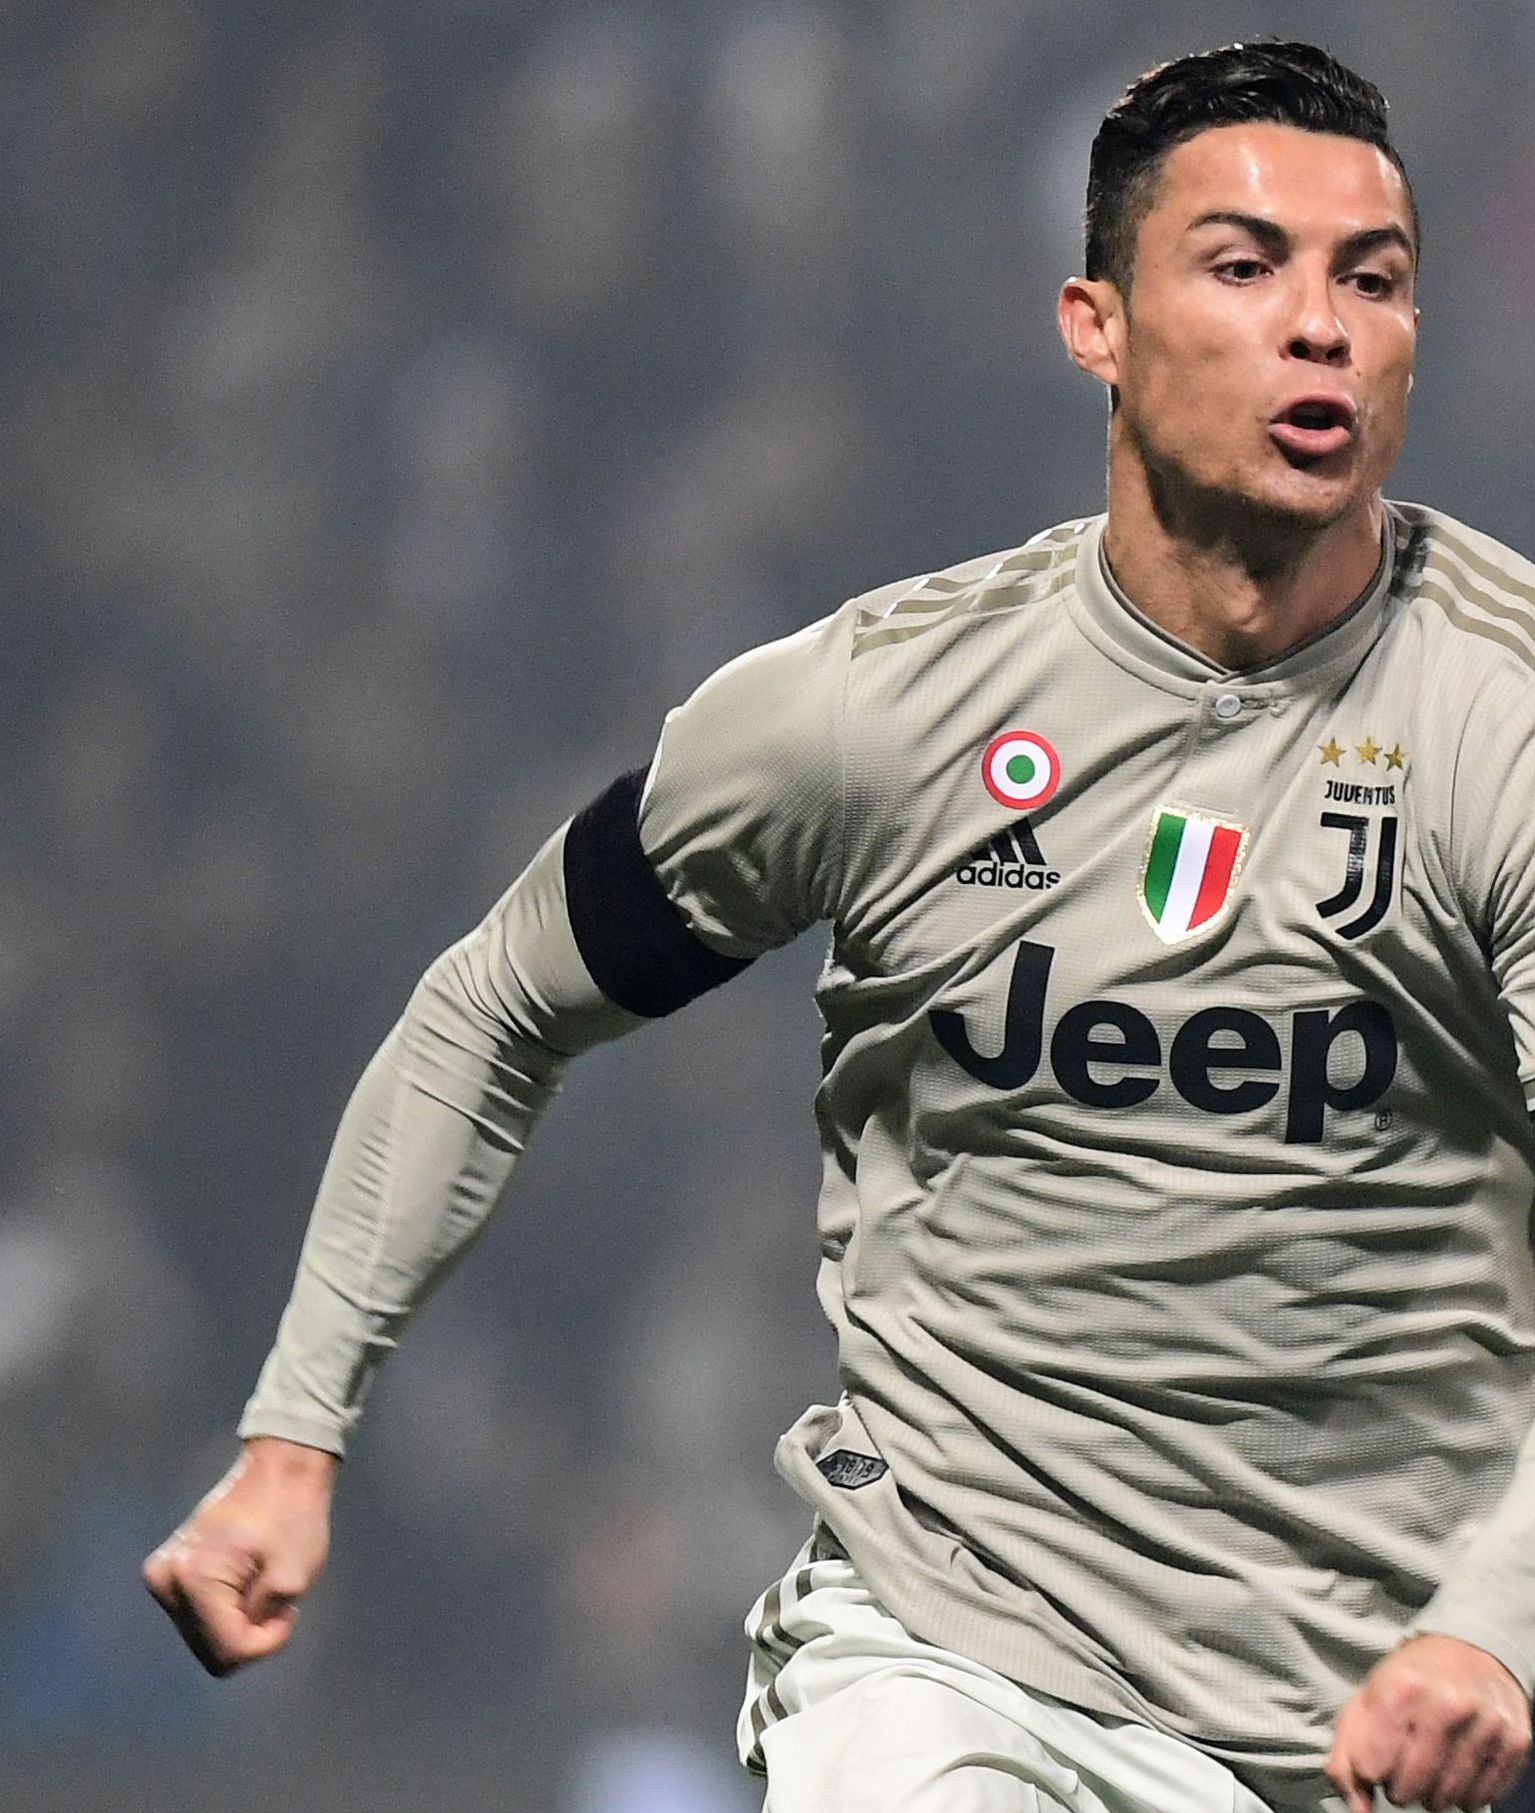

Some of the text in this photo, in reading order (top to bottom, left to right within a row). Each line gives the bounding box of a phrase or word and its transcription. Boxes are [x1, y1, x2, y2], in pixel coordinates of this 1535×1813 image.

[1324, 780, 1396, 805] JUVENTUS
[957, 862, 1061, 890] adidas
[929, 940, 1399, 1144] Jeep
